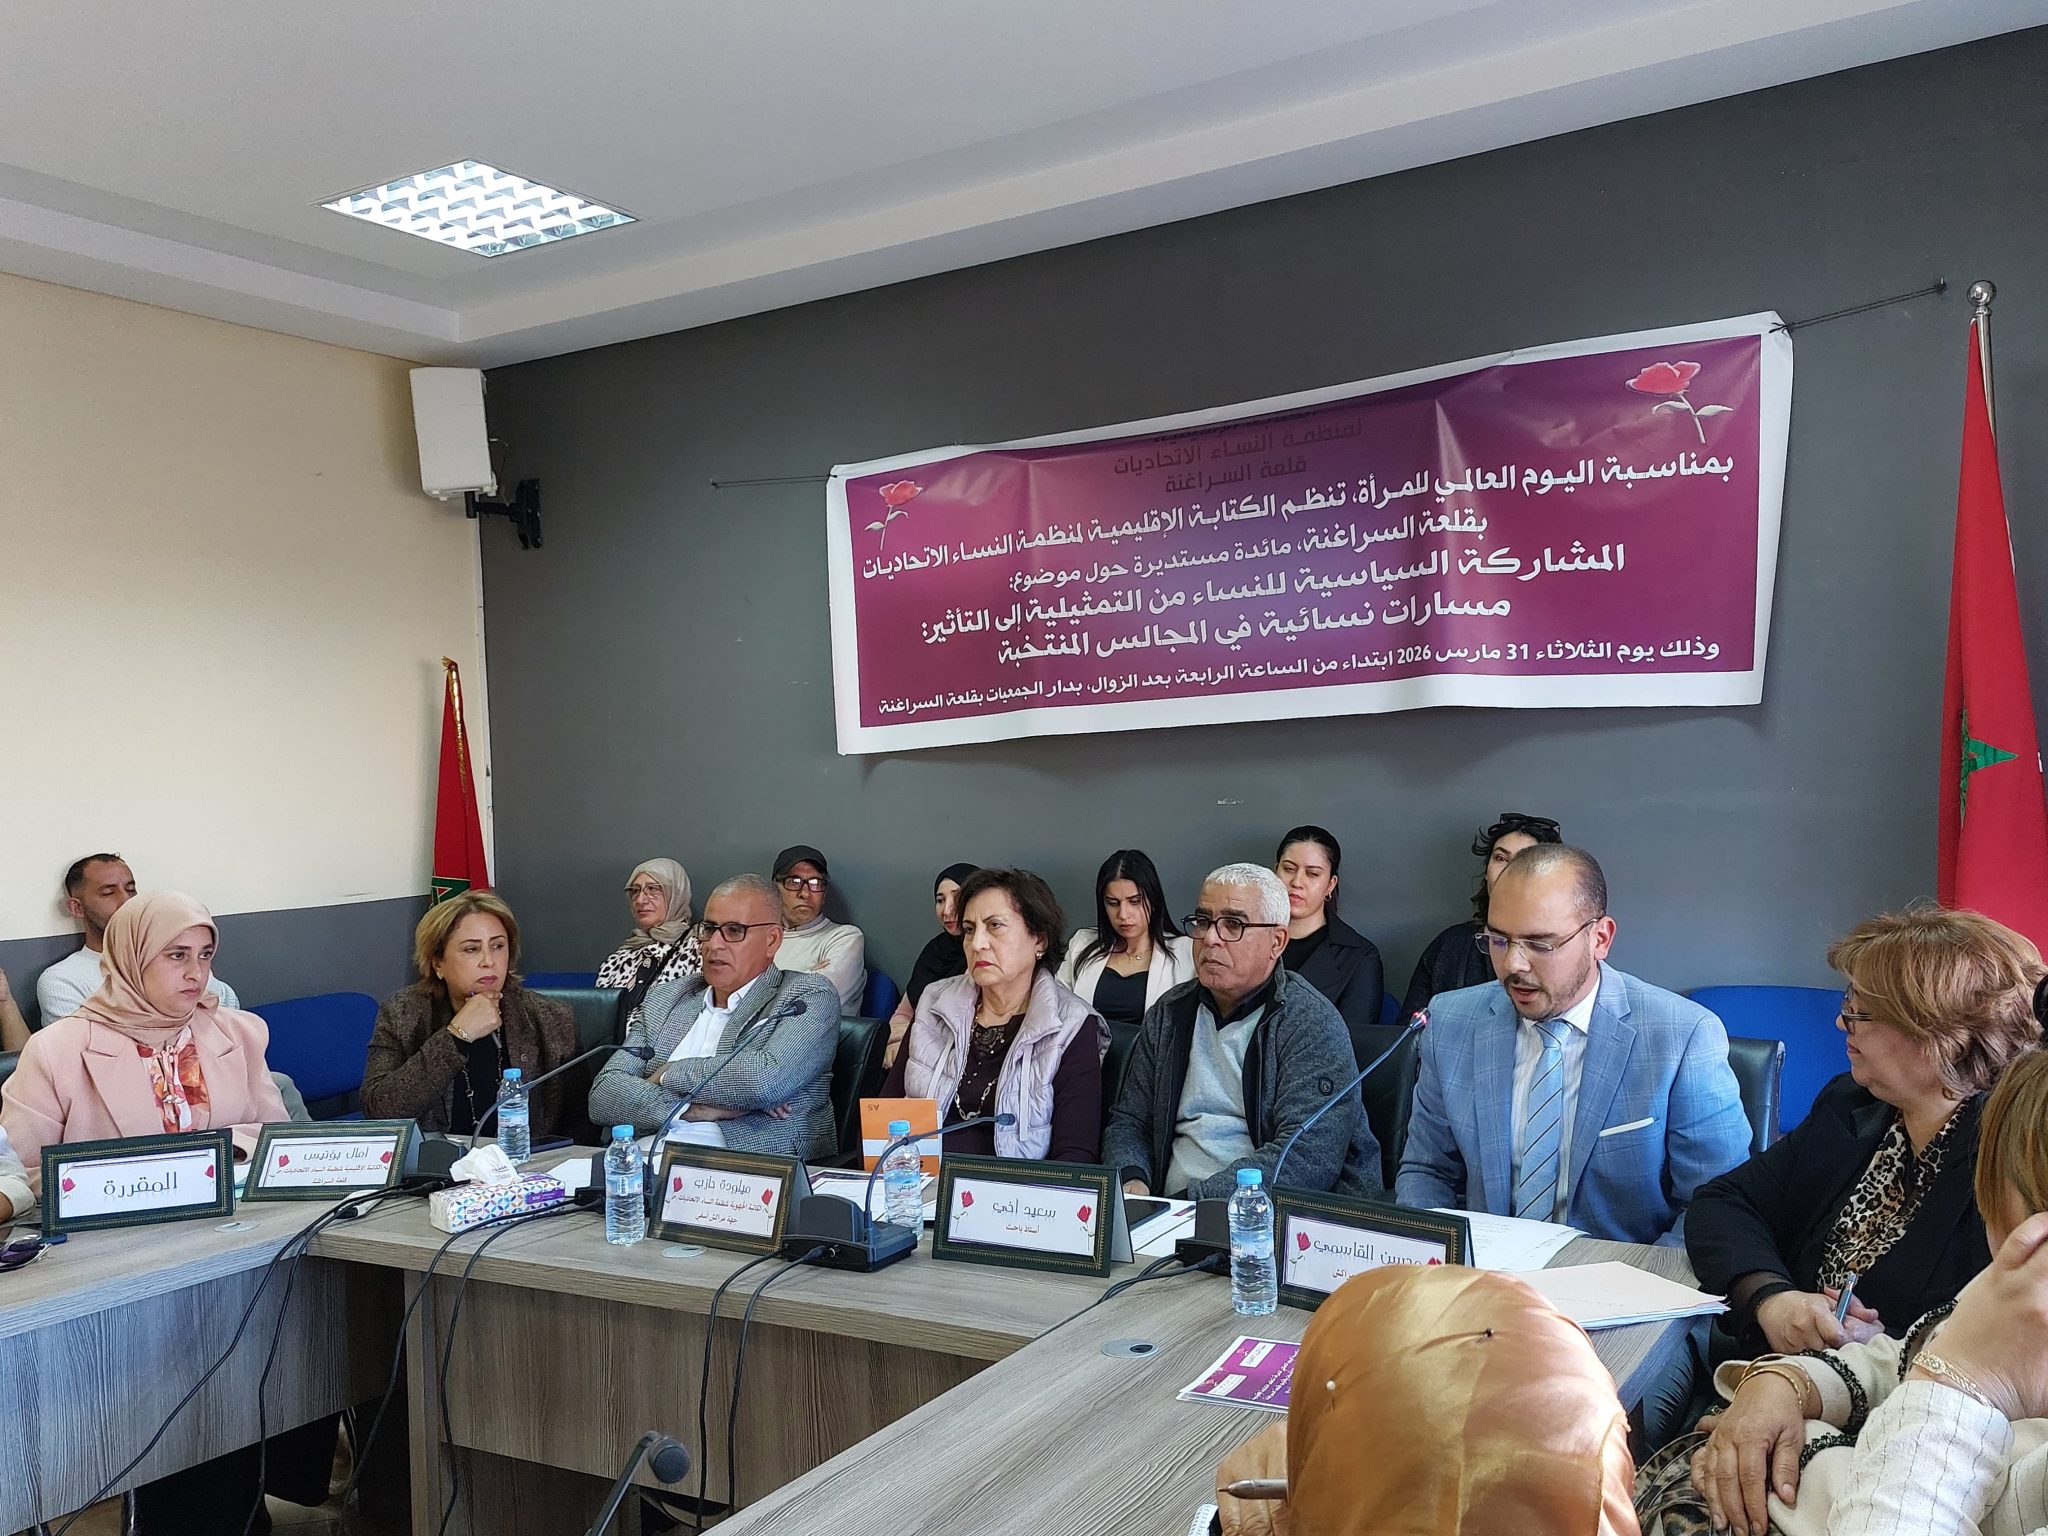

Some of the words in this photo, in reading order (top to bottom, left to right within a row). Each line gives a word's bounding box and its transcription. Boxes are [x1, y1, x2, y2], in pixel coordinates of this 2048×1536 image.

[1210, 433, 1273, 460] النساء
[1114, 445, 1200, 476] الاتحاديات
[1600, 451, 1734, 490] بمناسبة
[1165, 465, 1251, 493] السراغنة
[1434, 464, 1516, 504] العالمي
[1521, 458, 1594, 497] اليوم
[1188, 493, 1276, 531] الكتابة
[1280, 481, 1346, 522] تنظم
[1015, 522, 1084, 552] لمنظمة
[1087, 507, 1183, 546] الإقليمية
[1418, 507, 1488, 541] بقلعة
[863, 544, 949, 581] الاتحاديات
[952, 533, 1013, 565] النساء
[1234, 538, 1292, 561] مائدة
[1457, 540, 1625, 582] المشاركة
[1085, 561, 1129, 584] حول
[1133, 549, 1230, 578] مستديرة
[1293, 549, 1449, 599] السياسية
[1148, 588, 1186, 615] من
[1192, 571, 1287, 606] للنساء
[994, 602, 1021, 632] إلى
[1025, 588, 1142, 627] التمثيلية
[1382, 591, 1511, 626] مسارات
[1214, 613, 1252, 652] في
[1258, 601, 1375, 642] نسائية
[998, 631, 1089, 668] المنتخبة
[1096, 618, 1207, 658] المجالس
[1535, 639, 1612, 660] الثلاثاء
[1659, 635, 1720, 660] وذلك
[1342, 650, 1393, 671] ابتداء
[1397, 644, 1432, 664] 2026
[1435, 643, 1501, 663] مارس
[1505, 643, 1529, 661] 31
[1616, 644, 1655, 664] يوم
[1175, 664, 1234, 686] الرابعة
[1238, 658, 1308, 679] الساعة
[1312, 658, 1338, 676] من
[986, 680, 1043, 704] الجمعيات
[1050, 679, 1083, 698] بدار
[1141, 674, 1172, 689] بعد
[878, 694, 944, 715] السراغنة
[945, 689, 984, 707] بقلعة
[104, 1171, 177, 1198] المقررة
[719, 1179, 751, 1195] ميلودة
[1023, 1206, 1057, 1218] سعيد
[1005, 1223, 1022, 1234] باحث
[1313, 1240, 1374, 1261] القاسمي
